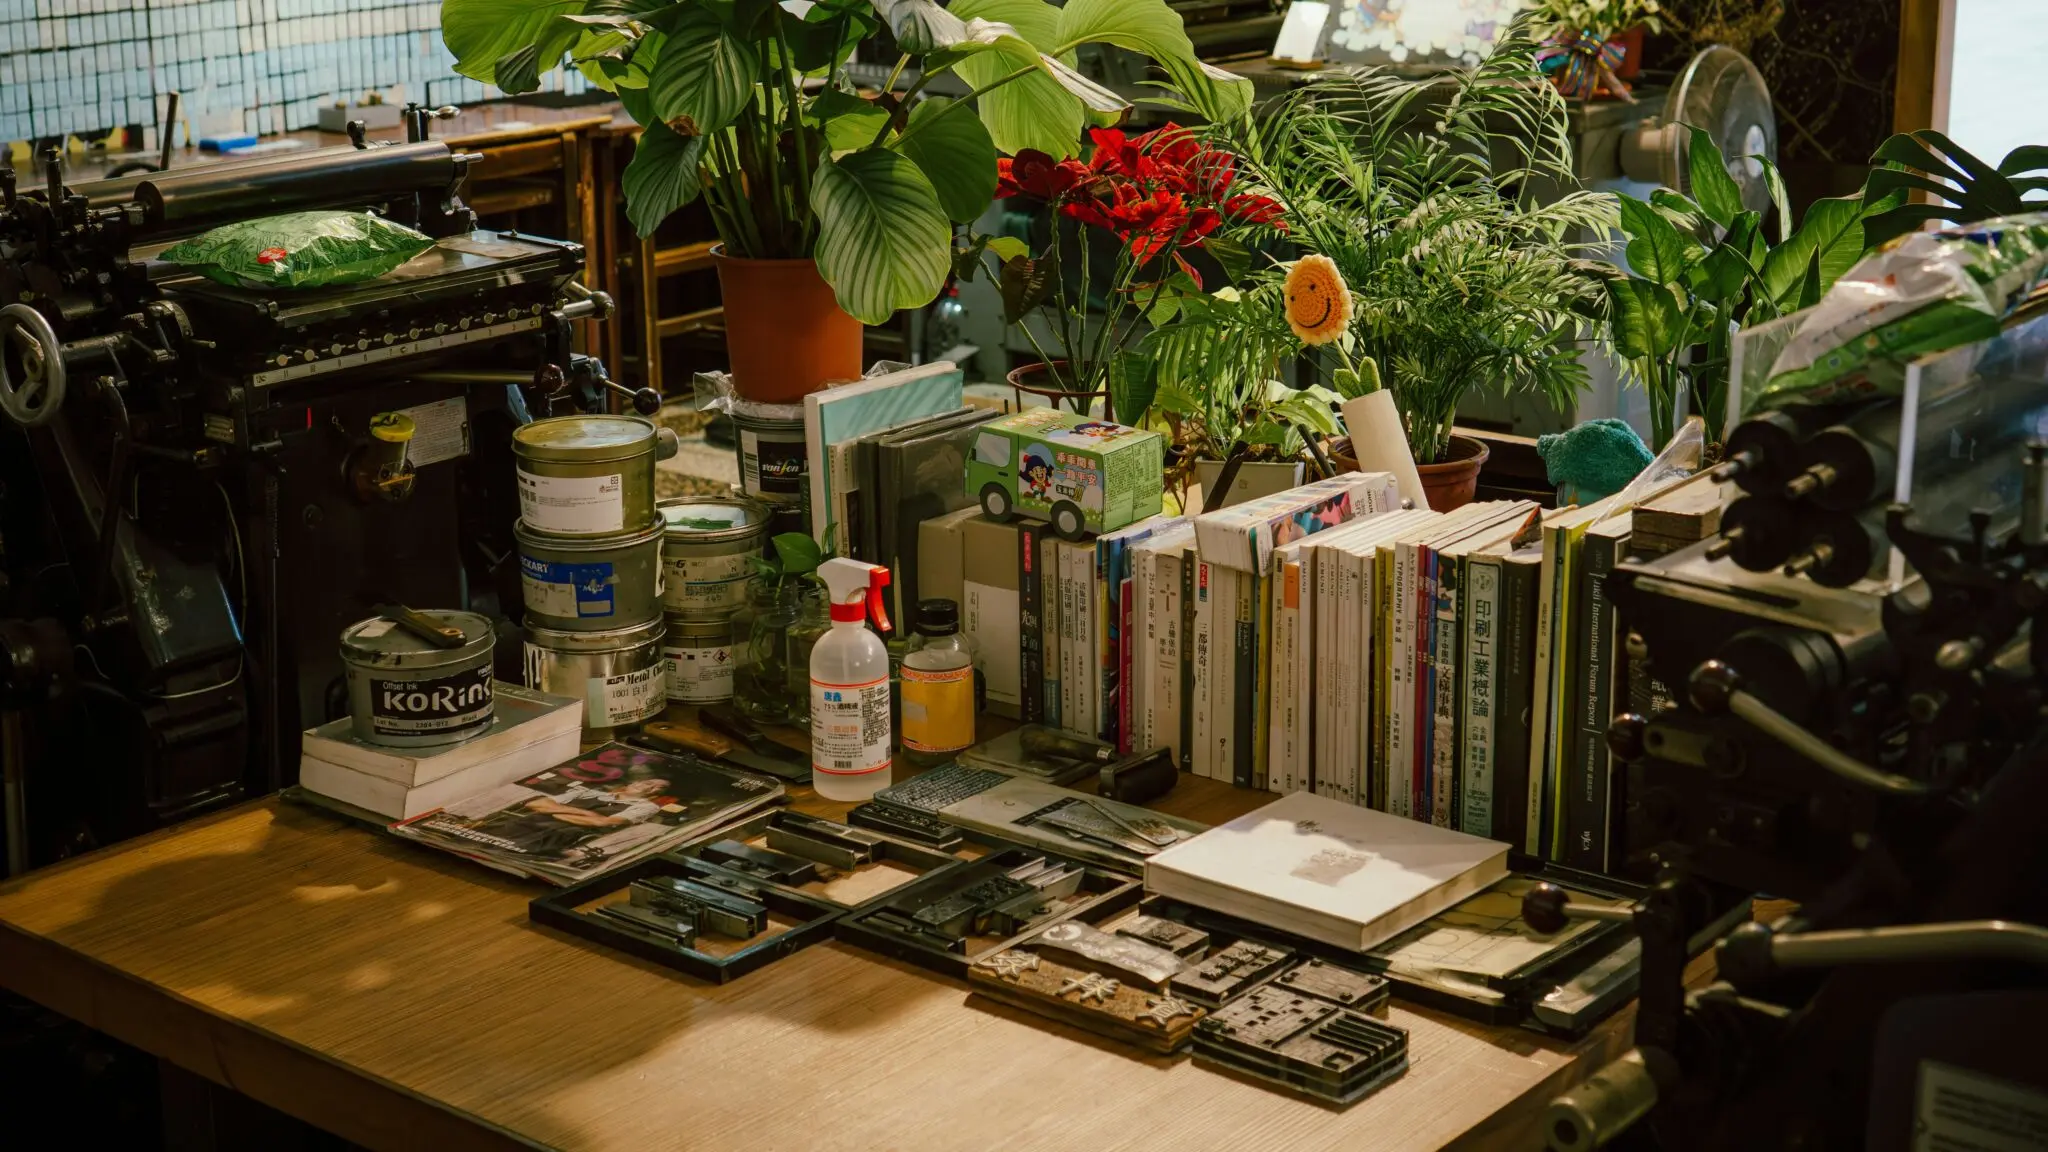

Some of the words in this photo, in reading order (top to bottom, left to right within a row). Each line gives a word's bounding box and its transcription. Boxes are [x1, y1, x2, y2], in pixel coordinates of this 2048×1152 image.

[1396, 561, 1404, 614] TYPOGRAPHY
[1590, 603, 1601, 662] International
[1472, 599, 1491, 718] 印刷工業概論
[383, 681, 404, 691] Offset
[406, 681, 418, 690] Ink
[626, 669, 650, 685] Metal
[1589, 663, 1599, 694] Forum
[612, 689, 629, 699] 1001
[1587, 693, 1598, 726] Report
